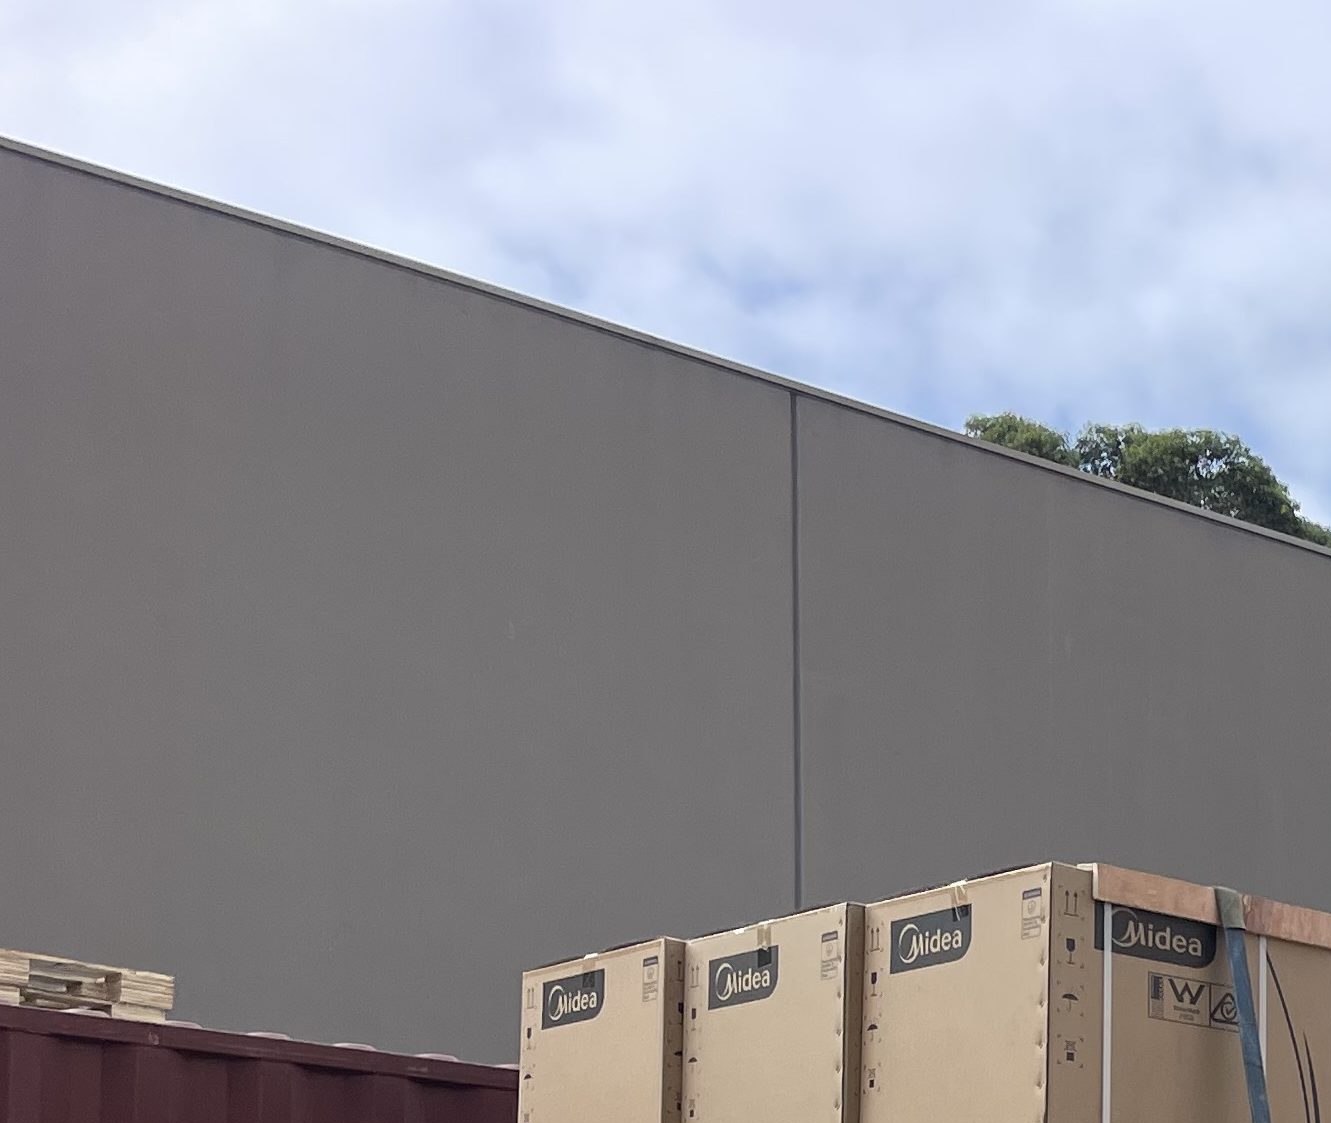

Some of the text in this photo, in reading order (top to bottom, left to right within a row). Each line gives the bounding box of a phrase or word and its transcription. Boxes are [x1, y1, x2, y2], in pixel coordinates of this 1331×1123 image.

[899, 923, 962, 964] Midea
[1110, 907, 1202, 957] Midea
[715, 962, 770, 1001] Midea
[548, 984, 597, 1021] Midea
